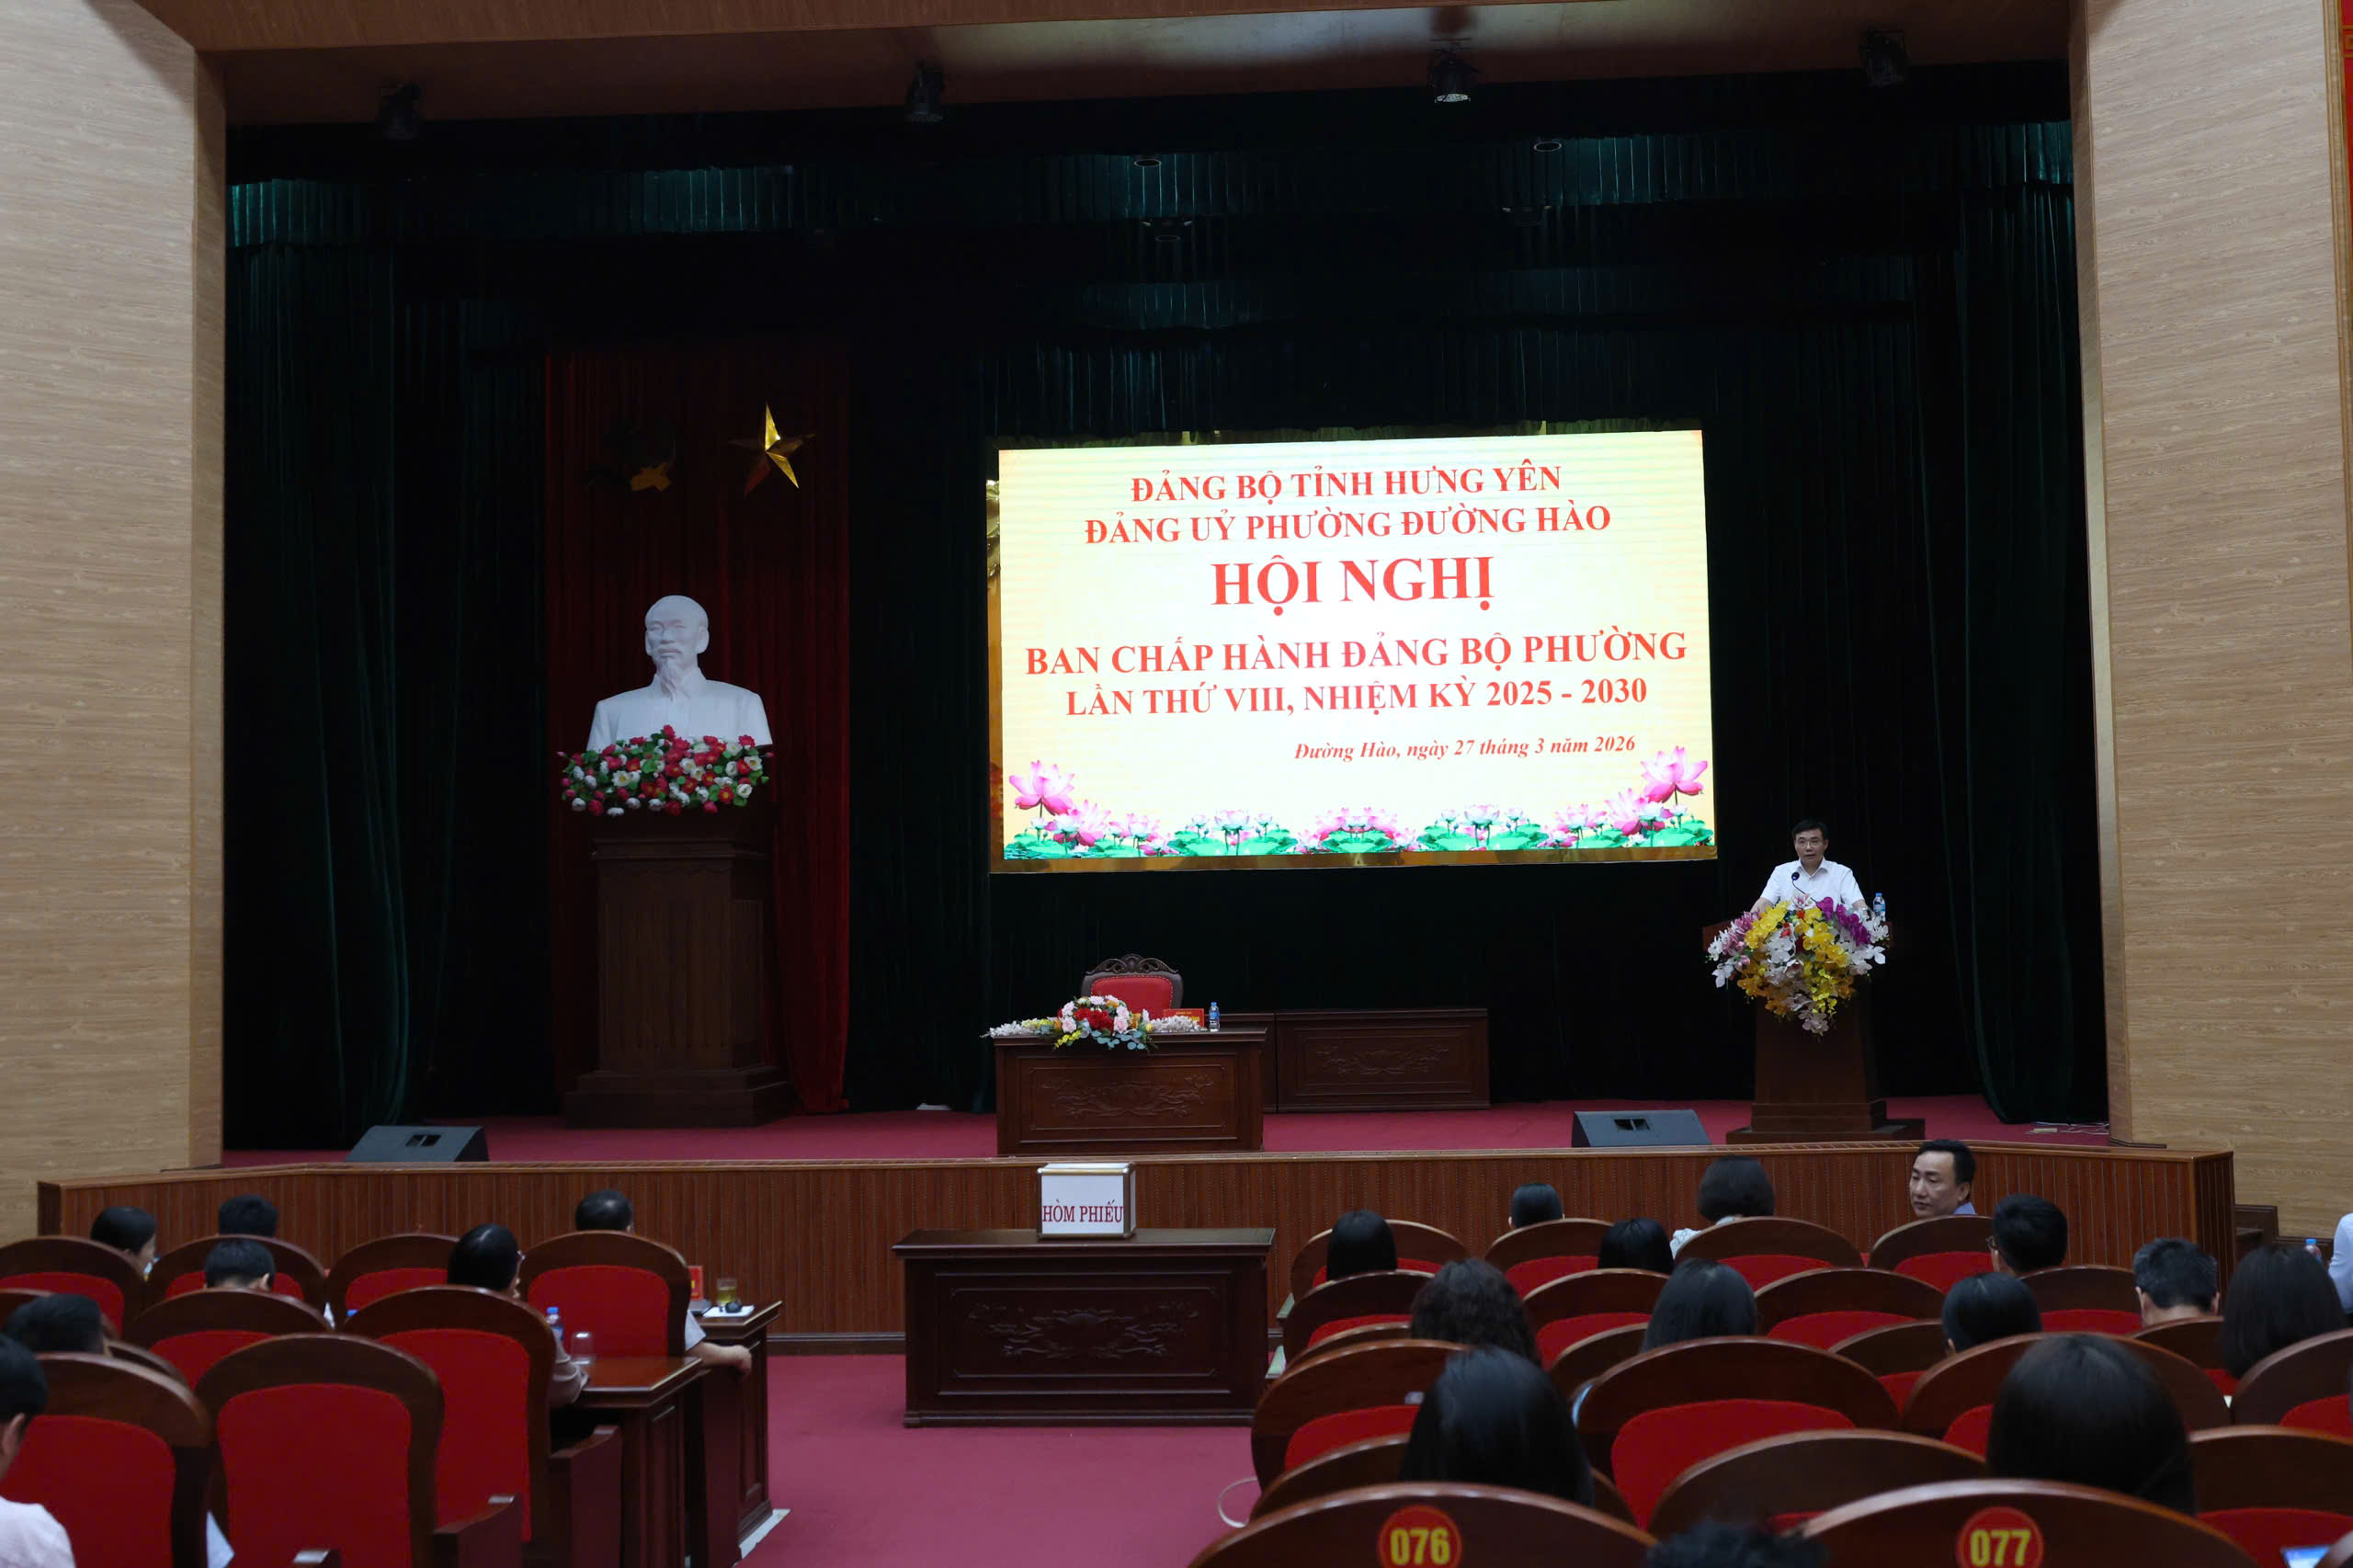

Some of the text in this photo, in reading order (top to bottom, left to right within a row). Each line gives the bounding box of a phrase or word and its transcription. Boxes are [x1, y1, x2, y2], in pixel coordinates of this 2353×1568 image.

[1131, 458, 1562, 505] ĐẢNG BỘ TỈNH HƯNG YÊN
[1085, 499, 1611, 544] ĐẢNG UỶ PHƯỜNG ĐƯỜNG HÀO
[1212, 555, 1495, 617] HỘI NGHỊ
[1026, 625, 1688, 676] BAN CHẤP HÀNH ĐẢNG BỘ PHƯỜNG
[1066, 683, 1133, 716] LẦN
[1142, 681, 1218, 714] THỨ
[1225, 687, 1294, 716] VIII,
[1303, 680, 1417, 716] NHIỆM
[1428, 675, 1476, 708] KỲ
[1486, 680, 1552, 706] 2025
[1581, 677, 1647, 704] 2030
[1294, 735, 1636, 763] Đường Hào, ngày 27 tháng 3 năm 2026
[1042, 1199, 1125, 1222] HÒM PHIẾU
[1391, 1528, 1450, 1565] 076
[1971, 1528, 2031, 1566] 077
